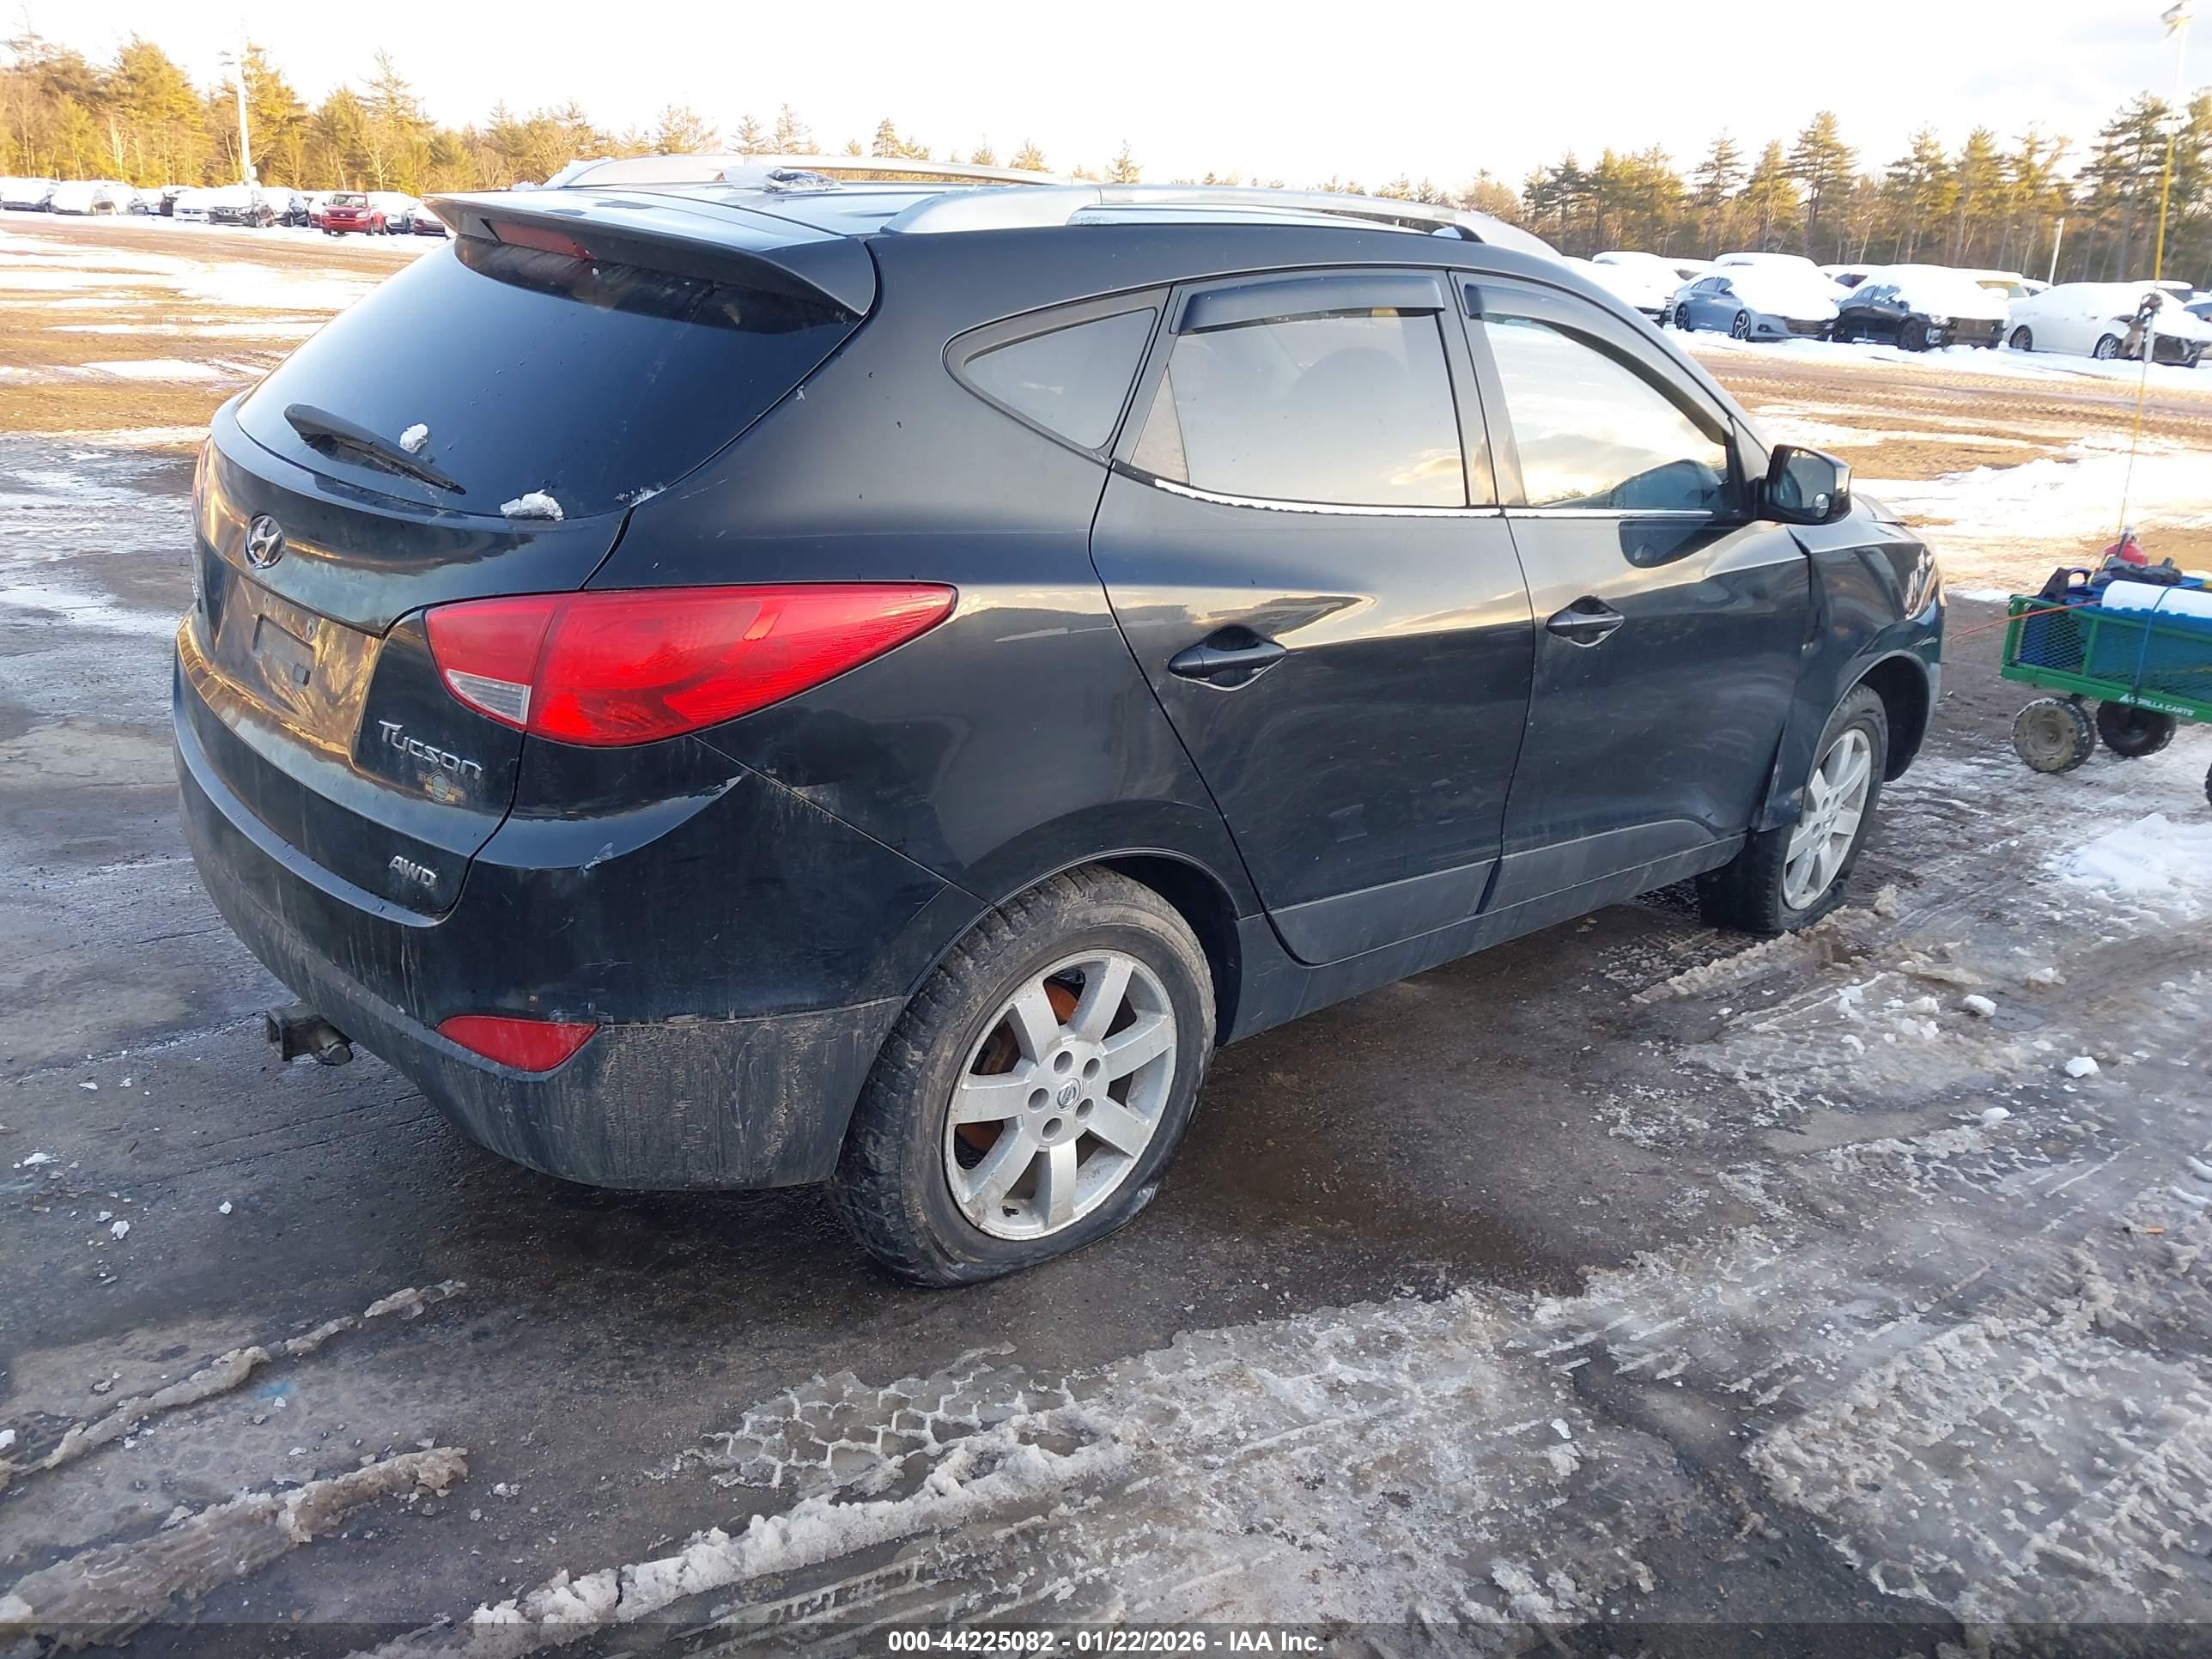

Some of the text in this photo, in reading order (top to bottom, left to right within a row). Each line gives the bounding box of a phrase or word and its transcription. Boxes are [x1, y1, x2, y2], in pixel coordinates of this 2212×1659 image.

[2165, 704, 2196, 716] CARTS
[379, 720, 483, 780] Tucson
[388, 855, 437, 886] AWD
